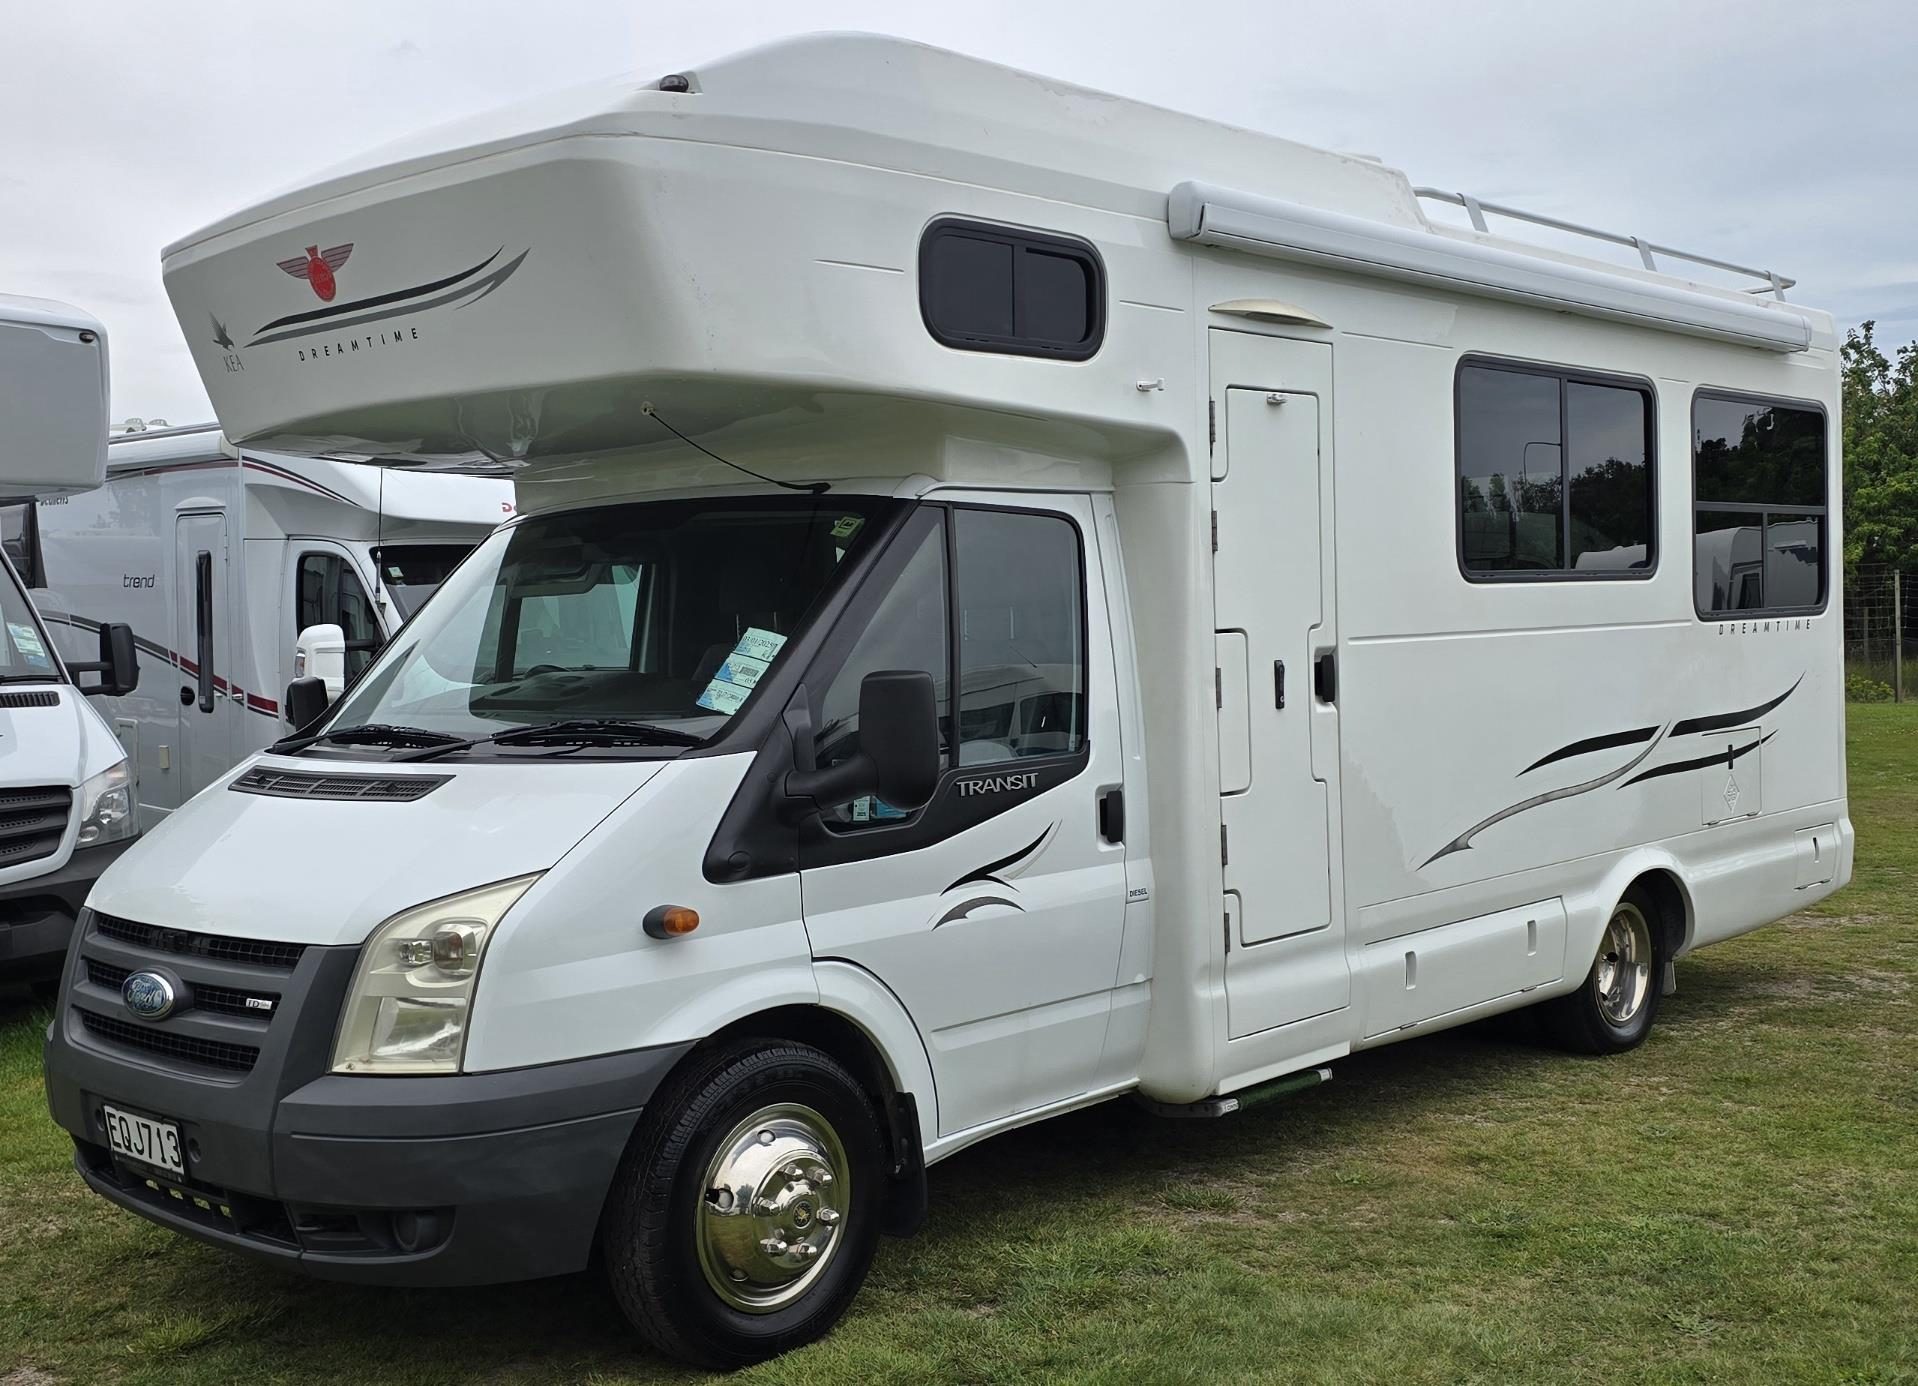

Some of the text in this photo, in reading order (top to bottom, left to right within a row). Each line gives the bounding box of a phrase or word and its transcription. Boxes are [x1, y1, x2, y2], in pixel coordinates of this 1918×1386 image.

[298, 327, 419, 362] DREAMTIME
[223, 354, 245, 373] KEA
[123, 573, 156, 589] trend
[1718, 619, 1811, 636] DREAMTIME
[956, 772, 1039, 797] TRANSIT
[1129, 887, 1148, 898] DIESEL
[106, 1111, 182, 1168] EQJ713
